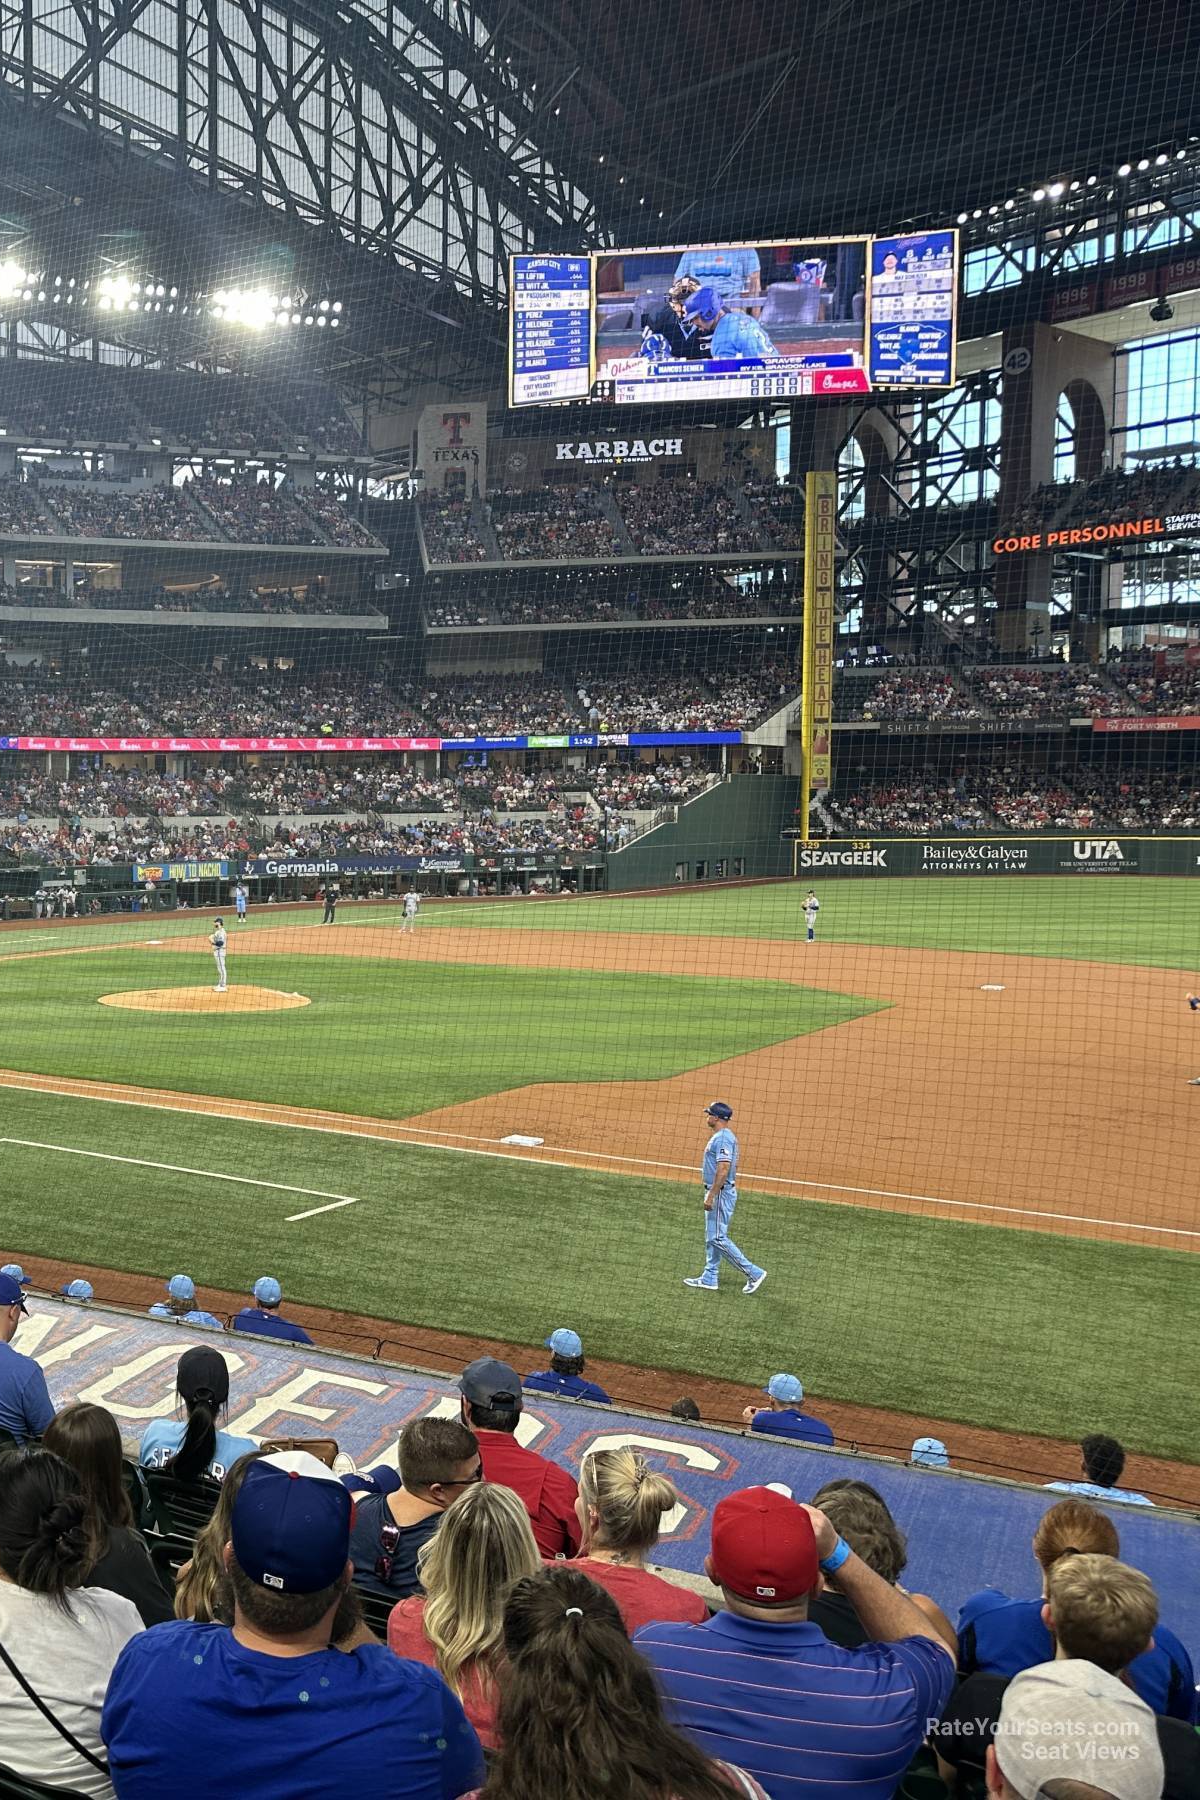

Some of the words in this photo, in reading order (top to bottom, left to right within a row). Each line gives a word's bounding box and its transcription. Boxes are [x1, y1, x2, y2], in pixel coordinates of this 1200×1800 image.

[1112, 272, 1146, 292] 1998
[1056, 286, 1089, 305] 1996
[1006, 351, 1029, 369] 42
[433, 450, 479, 461] TEXAS
[555, 438, 683, 460] KARBACH
[817, 499, 831, 587] BRING
[993, 534, 1042, 554] CORE
[1047, 518, 1165, 547] PERSONNEL
[816, 591, 830, 643] THE
[815, 650, 828, 719] HEAT
[887, 724, 921, 733] SHIFT
[979, 722, 1013, 731] SHIFT
[1146, 721, 1179, 730] WORTH
[852, 842, 871, 850] 334
[922, 845, 1028, 862] Bailey&Galyen
[1073, 840, 1124, 859] UTA
[265, 859, 339, 875] Germania
[800, 849, 888, 867] SEATGEEK
[922, 862, 981, 870] ATTORNEYS
[987, 862, 999, 870] AT
[169, 864, 186, 879] HOW
[189, 863, 197, 877] TO
[198, 862, 221, 877] NACHO
